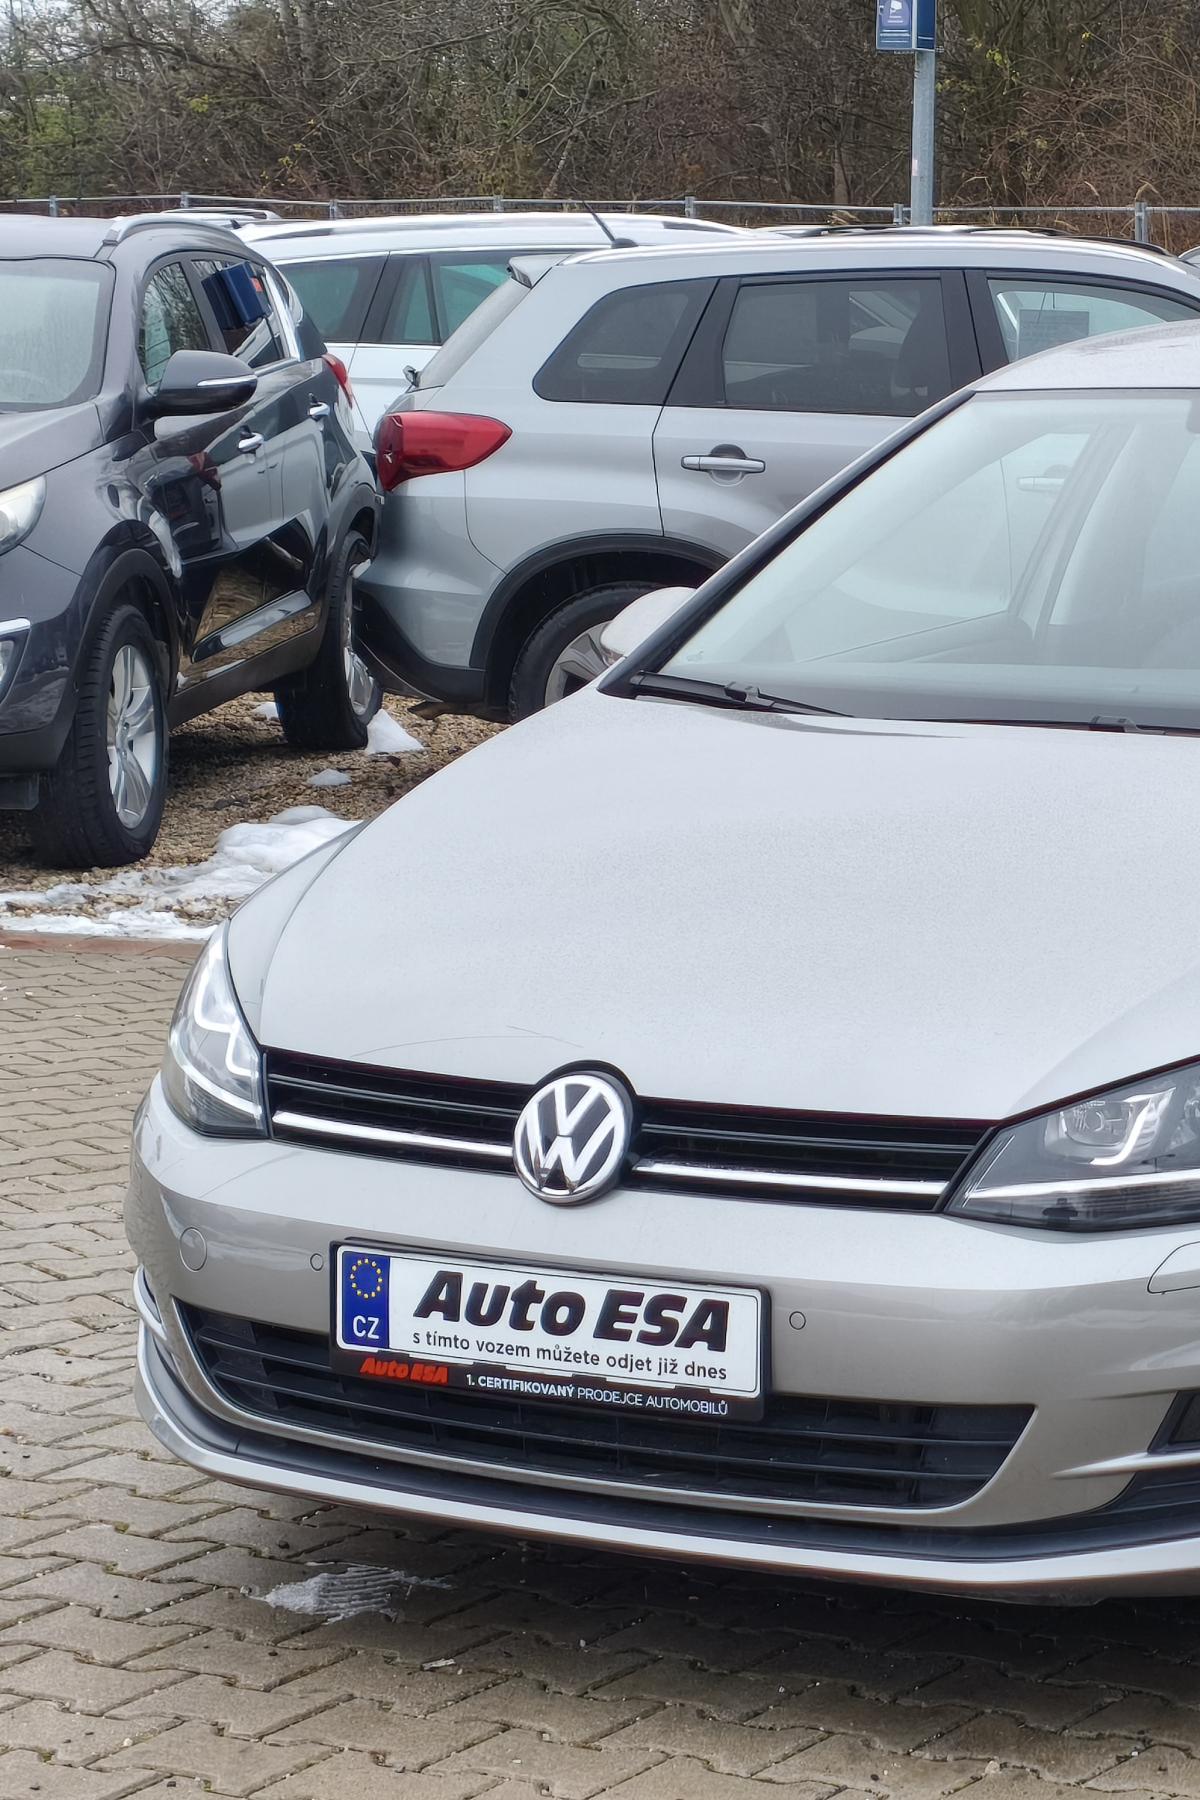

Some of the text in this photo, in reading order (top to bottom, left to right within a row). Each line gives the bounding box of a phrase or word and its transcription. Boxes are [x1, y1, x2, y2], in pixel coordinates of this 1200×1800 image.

[352, 1315, 380, 1340] CZ
[412, 1270, 730, 1353] Auto ESA
[359, 1357, 449, 1384] Auto ESA
[412, 1330, 727, 1380] s tímto vozem můžete odjet již dnes
[466, 1373, 728, 1415] 1. CERTIFIKOVANÝ PRODEJCE AUTOMOBILŮ
